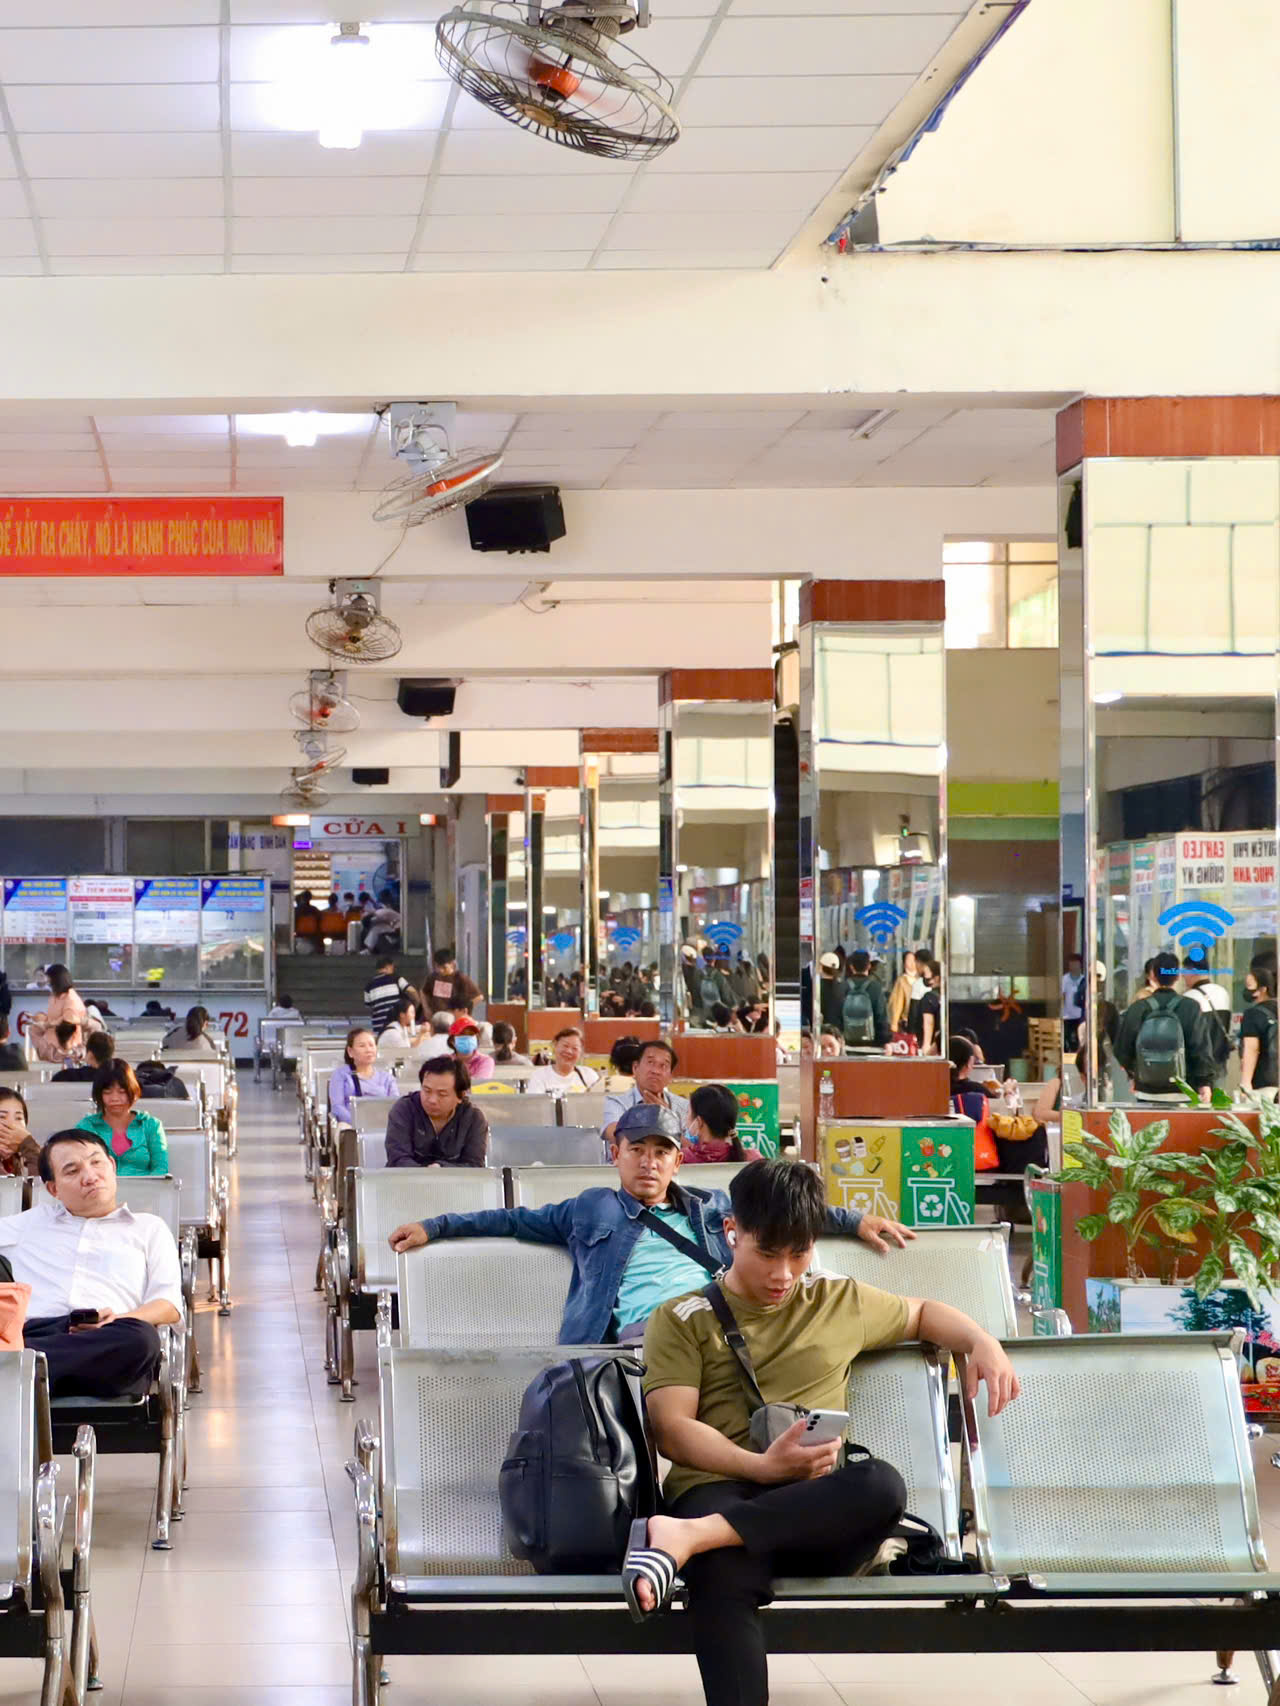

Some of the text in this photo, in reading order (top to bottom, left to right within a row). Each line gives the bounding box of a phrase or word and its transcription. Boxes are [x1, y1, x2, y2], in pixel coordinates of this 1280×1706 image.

[40, 520, 57, 556] RA
[114, 512, 129, 556] LÀ
[323, 817, 385, 835] CỬA
[219, 1011, 249, 1038] 72
